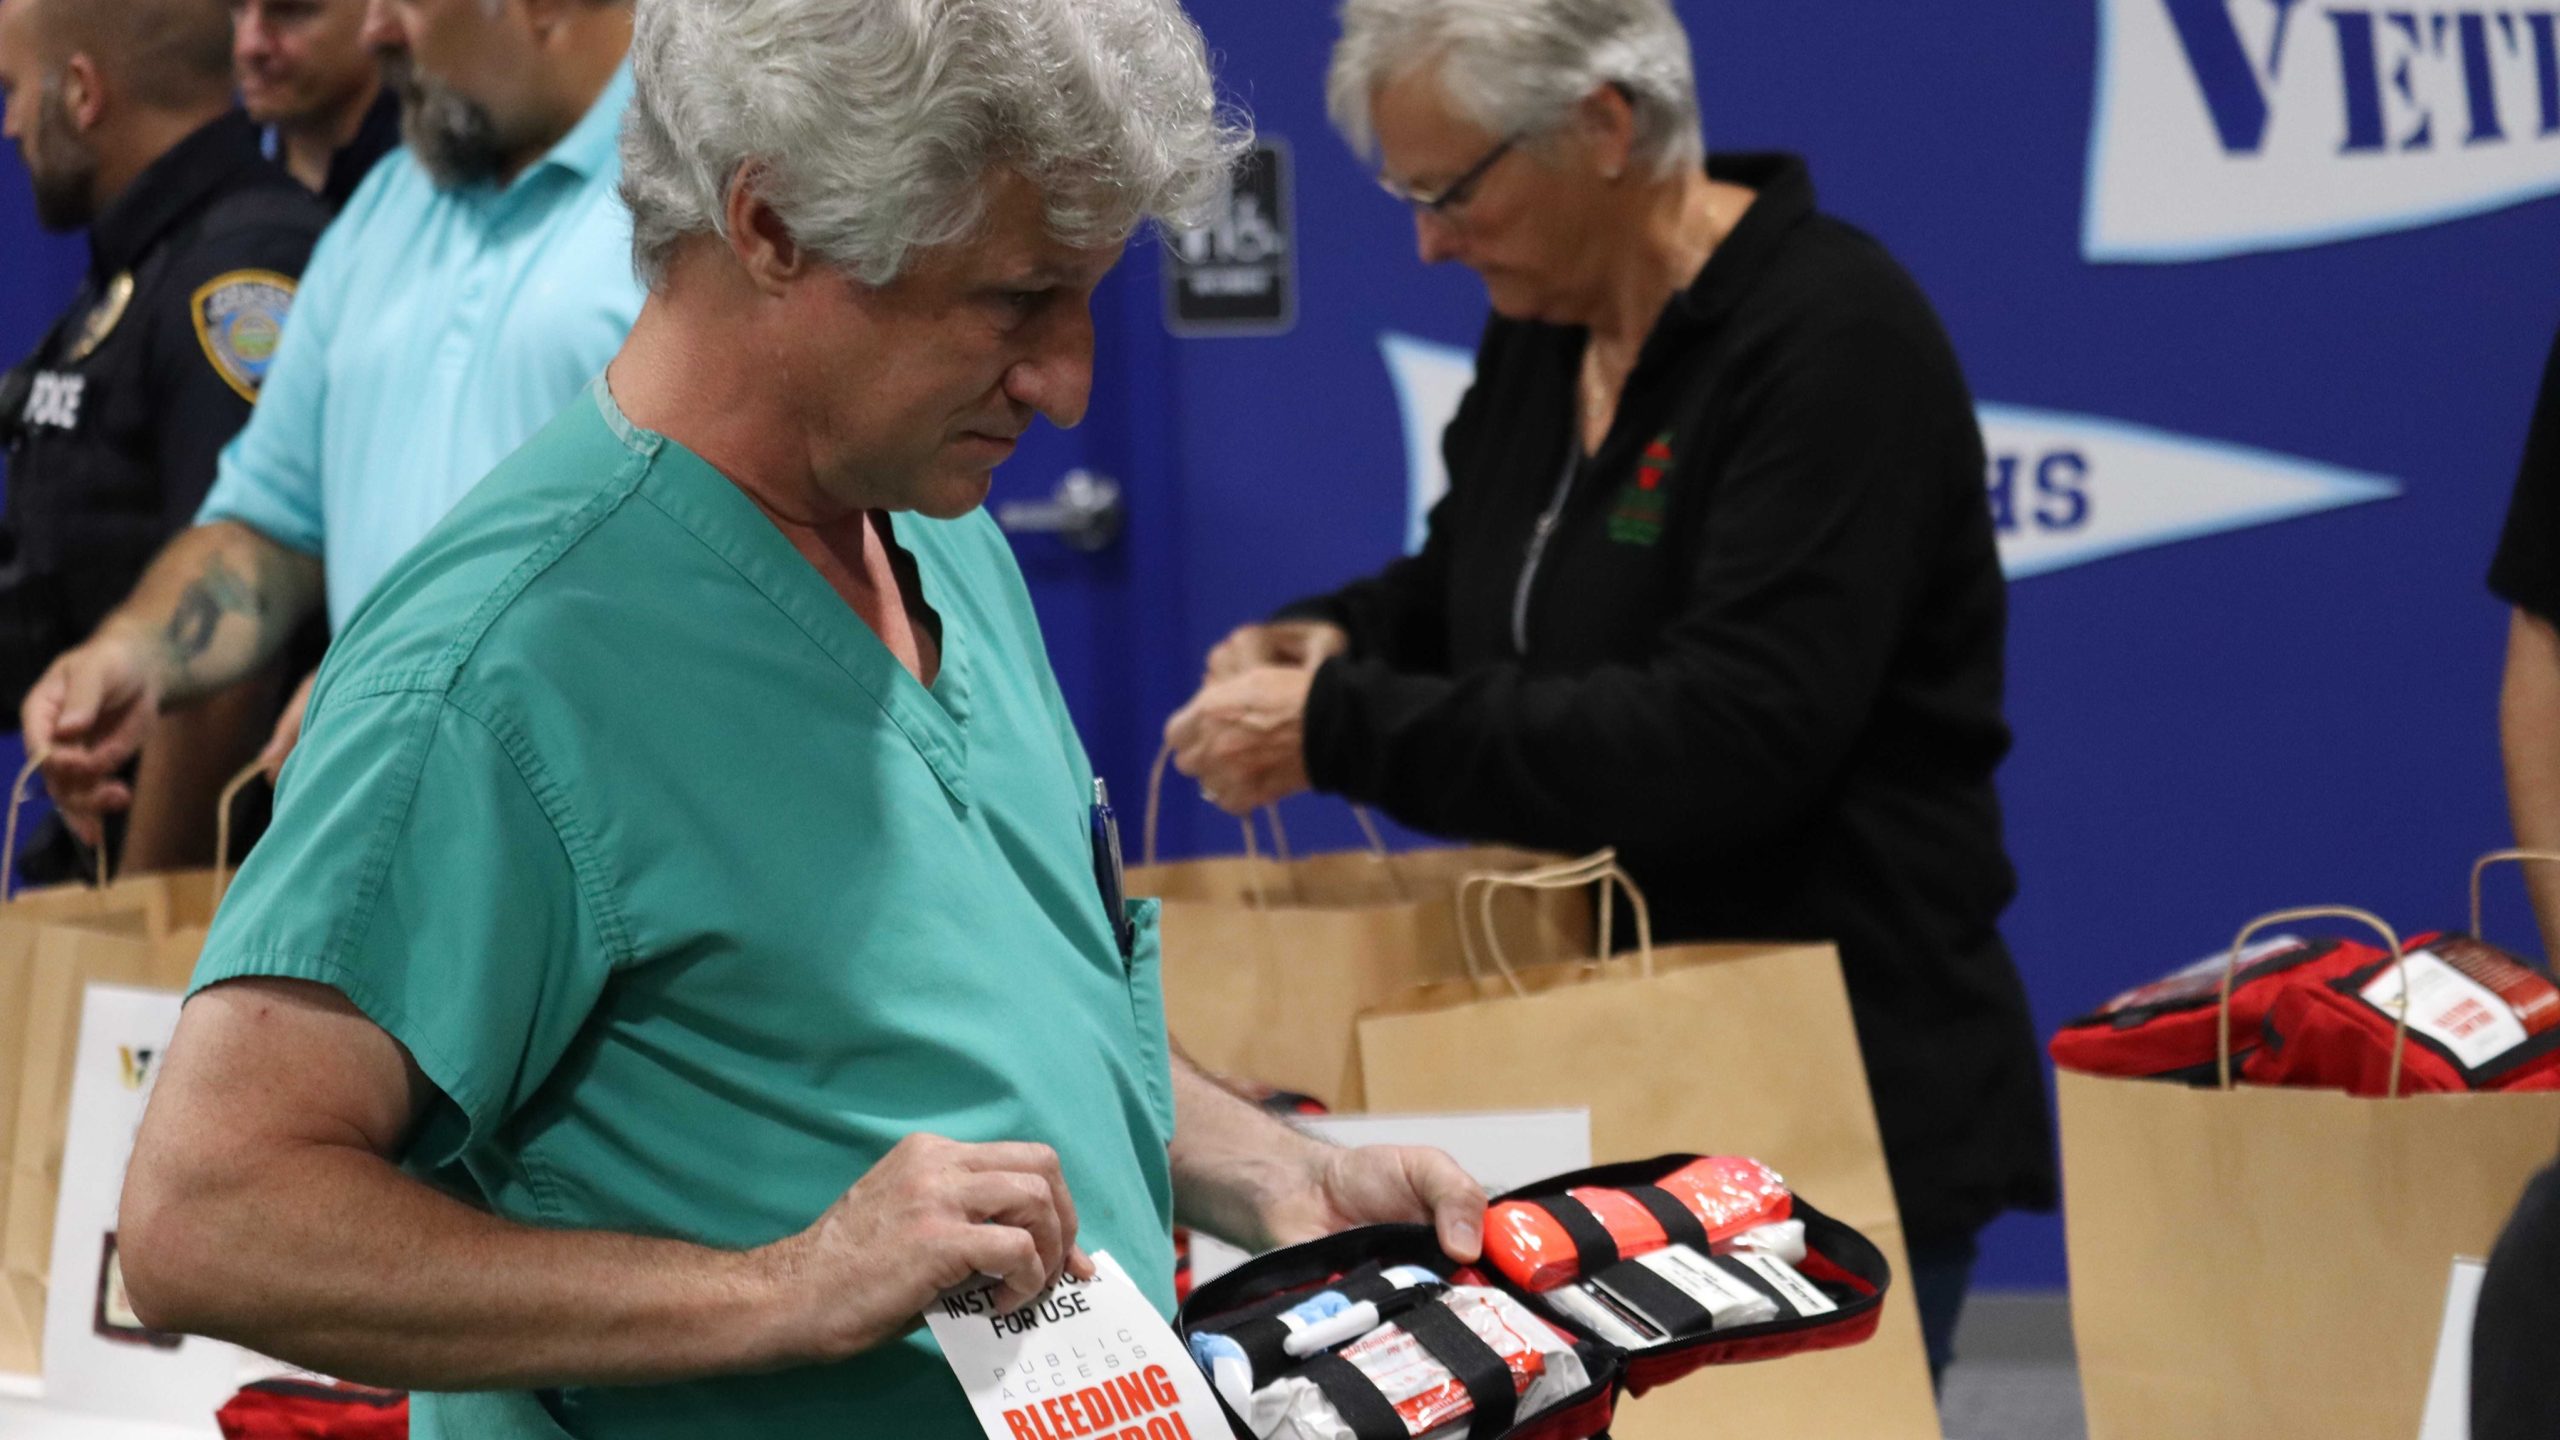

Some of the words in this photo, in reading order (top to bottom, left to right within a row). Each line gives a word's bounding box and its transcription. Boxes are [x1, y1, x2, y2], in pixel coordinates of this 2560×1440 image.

[990, 1308, 1039, 1339] FOR
[1038, 1291, 1091, 1324] USE
[993, 1328, 1133, 1383] PUBLIC
[1002, 1345, 1148, 1401] ACCESS
[1002, 1364, 1181, 1440] BLEEDING
